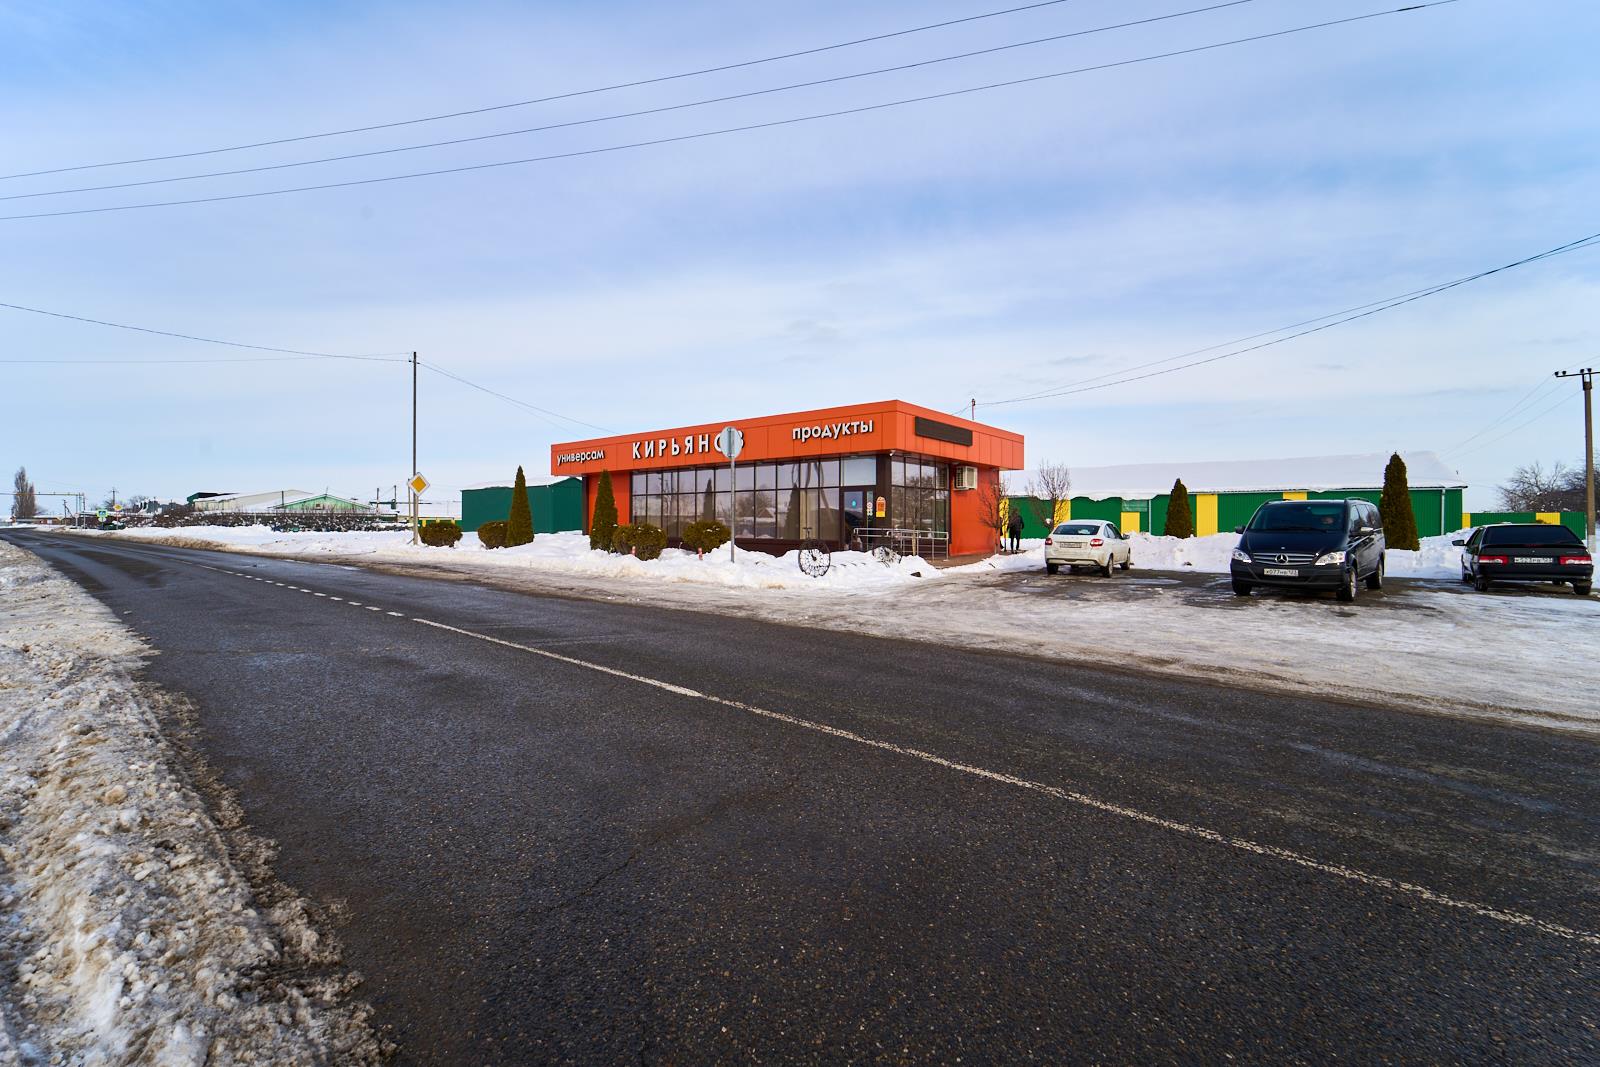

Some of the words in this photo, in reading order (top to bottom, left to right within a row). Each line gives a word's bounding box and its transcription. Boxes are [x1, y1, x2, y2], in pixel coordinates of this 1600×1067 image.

[792, 420, 873, 442] продукты
[632, 430, 743, 459] КИРЬЯН
[557, 450, 604, 466] универсам
